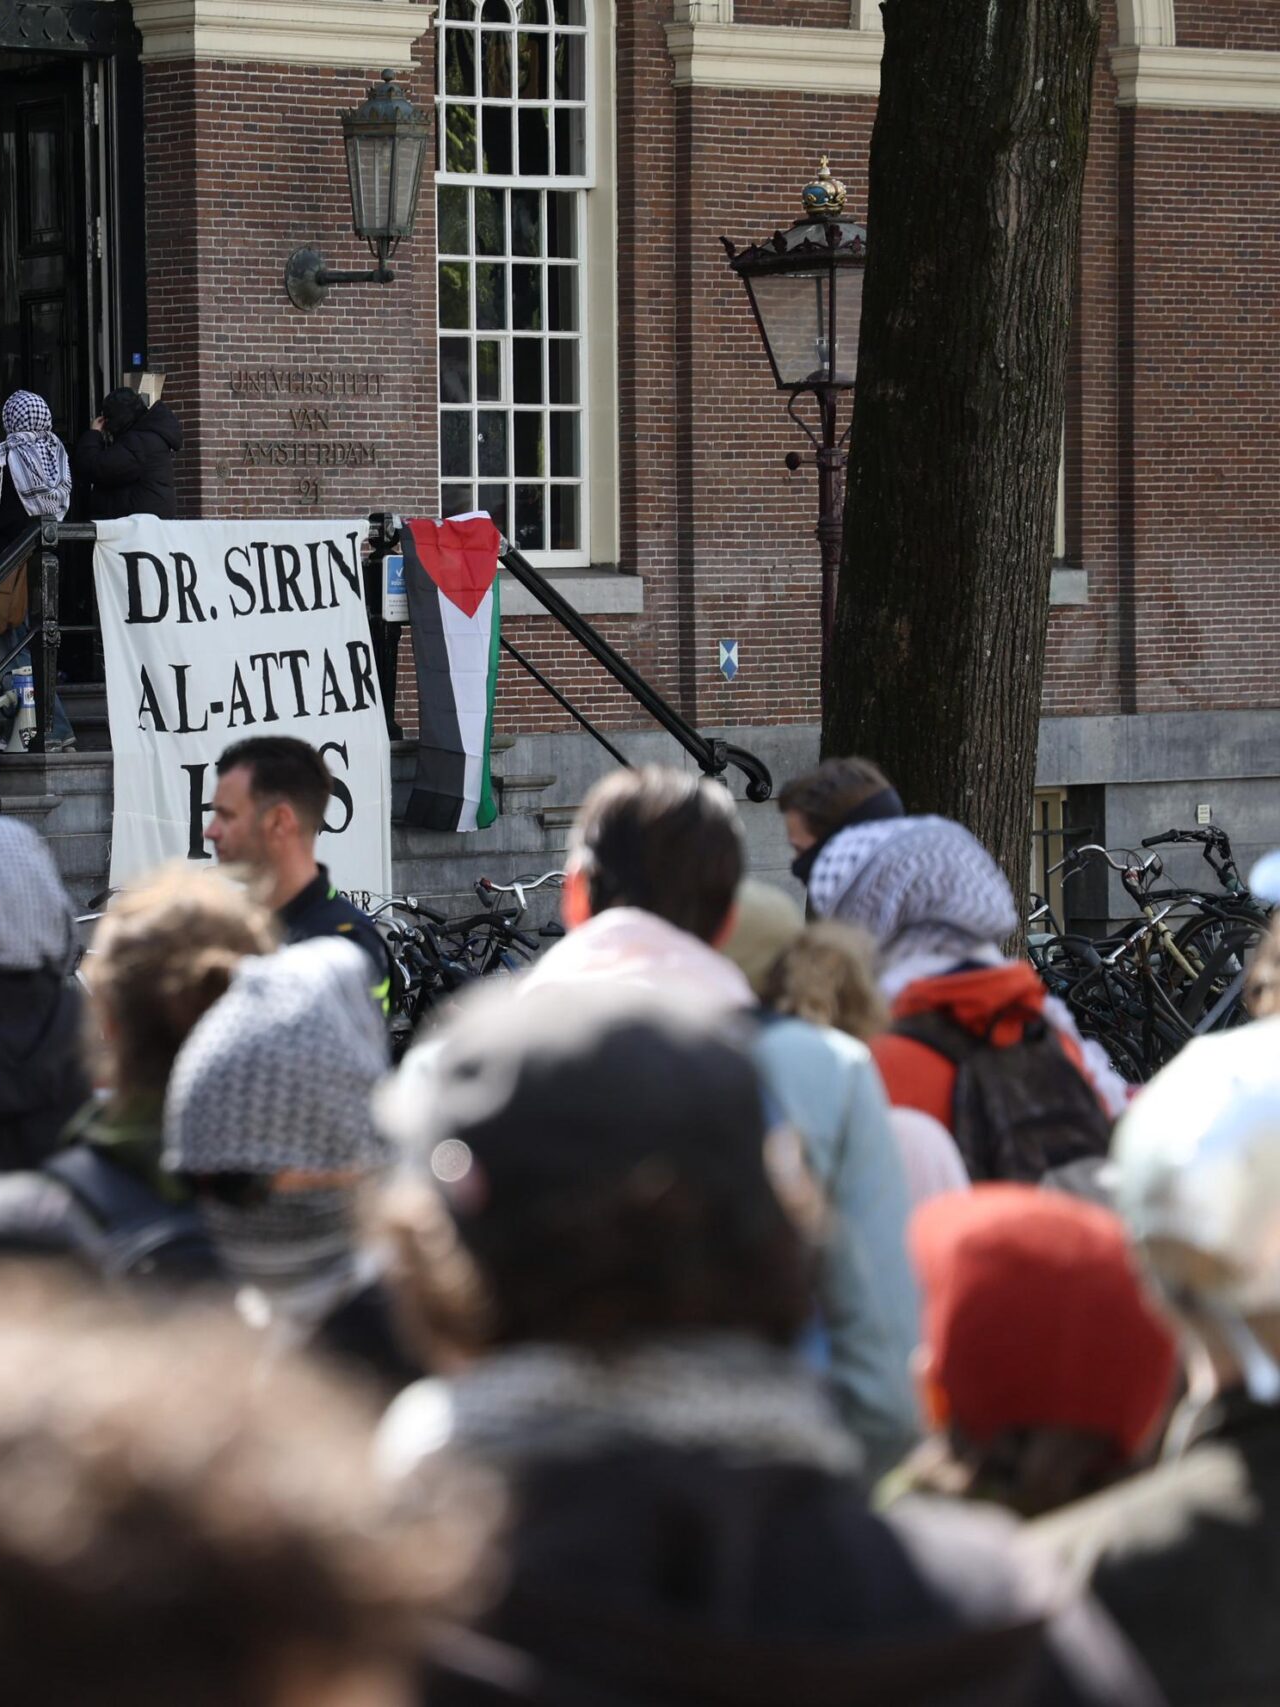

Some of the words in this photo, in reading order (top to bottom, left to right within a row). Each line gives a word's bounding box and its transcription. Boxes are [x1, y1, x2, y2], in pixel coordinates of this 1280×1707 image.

[231, 370, 384, 396] UNIVERSITEIT
[290, 408, 330, 431] VAN
[243, 442, 376, 466] AMSTERDAM
[120, 551, 218, 624] DR.
[224, 531, 362, 618] SIRIN
[138, 640, 377, 734] AL-ATTAR
